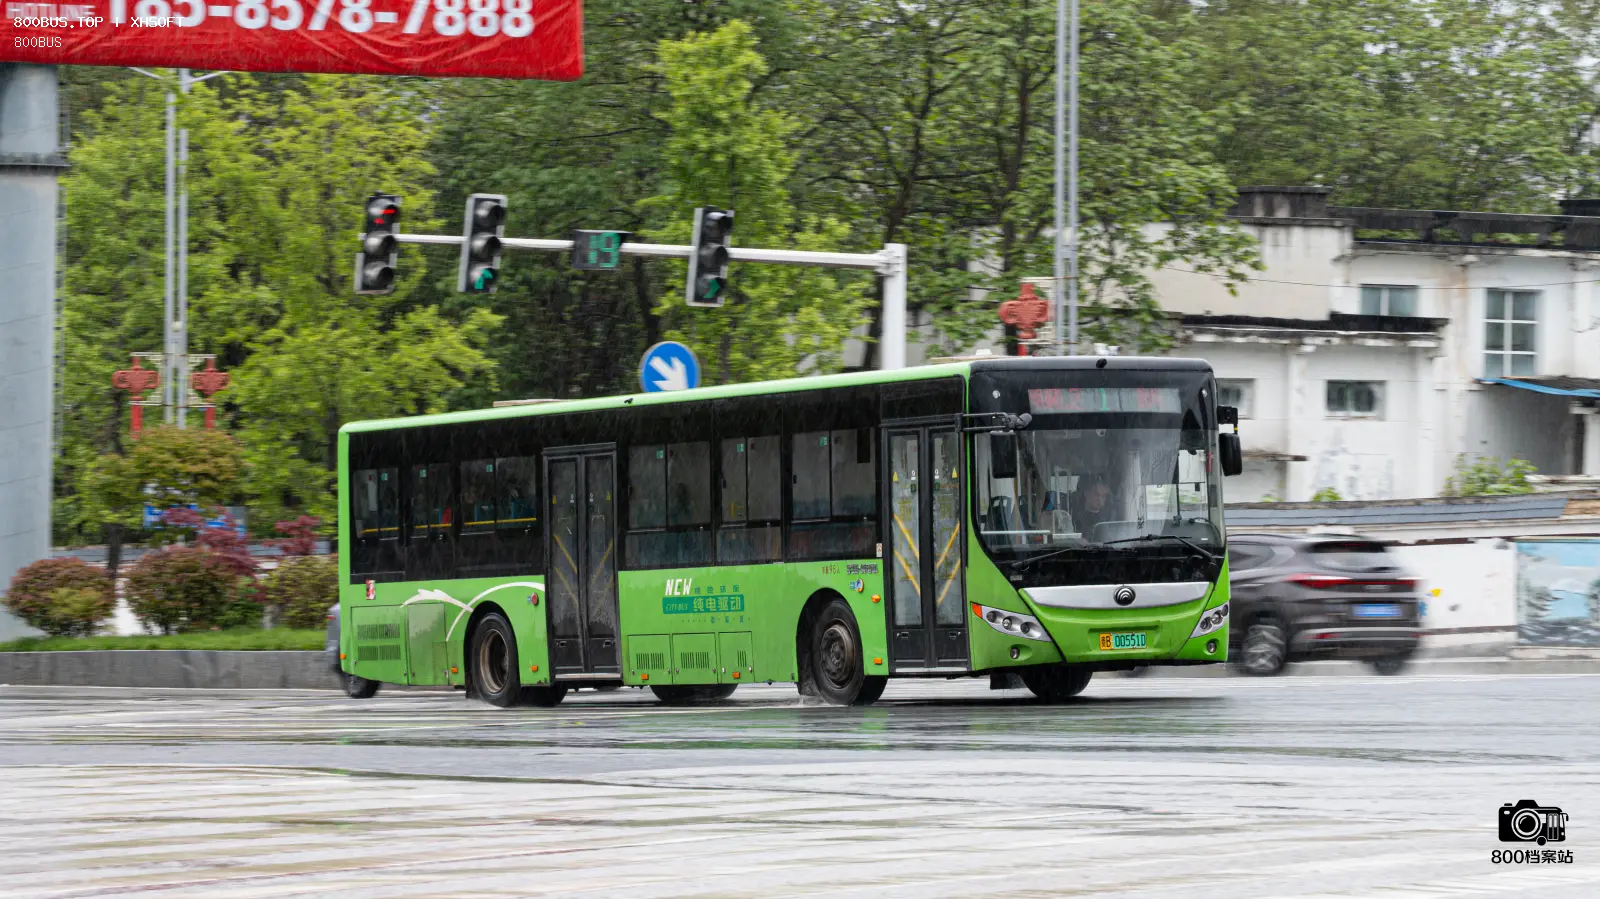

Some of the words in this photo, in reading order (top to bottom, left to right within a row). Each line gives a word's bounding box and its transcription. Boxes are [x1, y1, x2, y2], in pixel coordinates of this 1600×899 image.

[588, 232, 621, 268] 19
[665, 579, 692, 595] NEW
[693, 596, 740, 611] 纯电驱动
